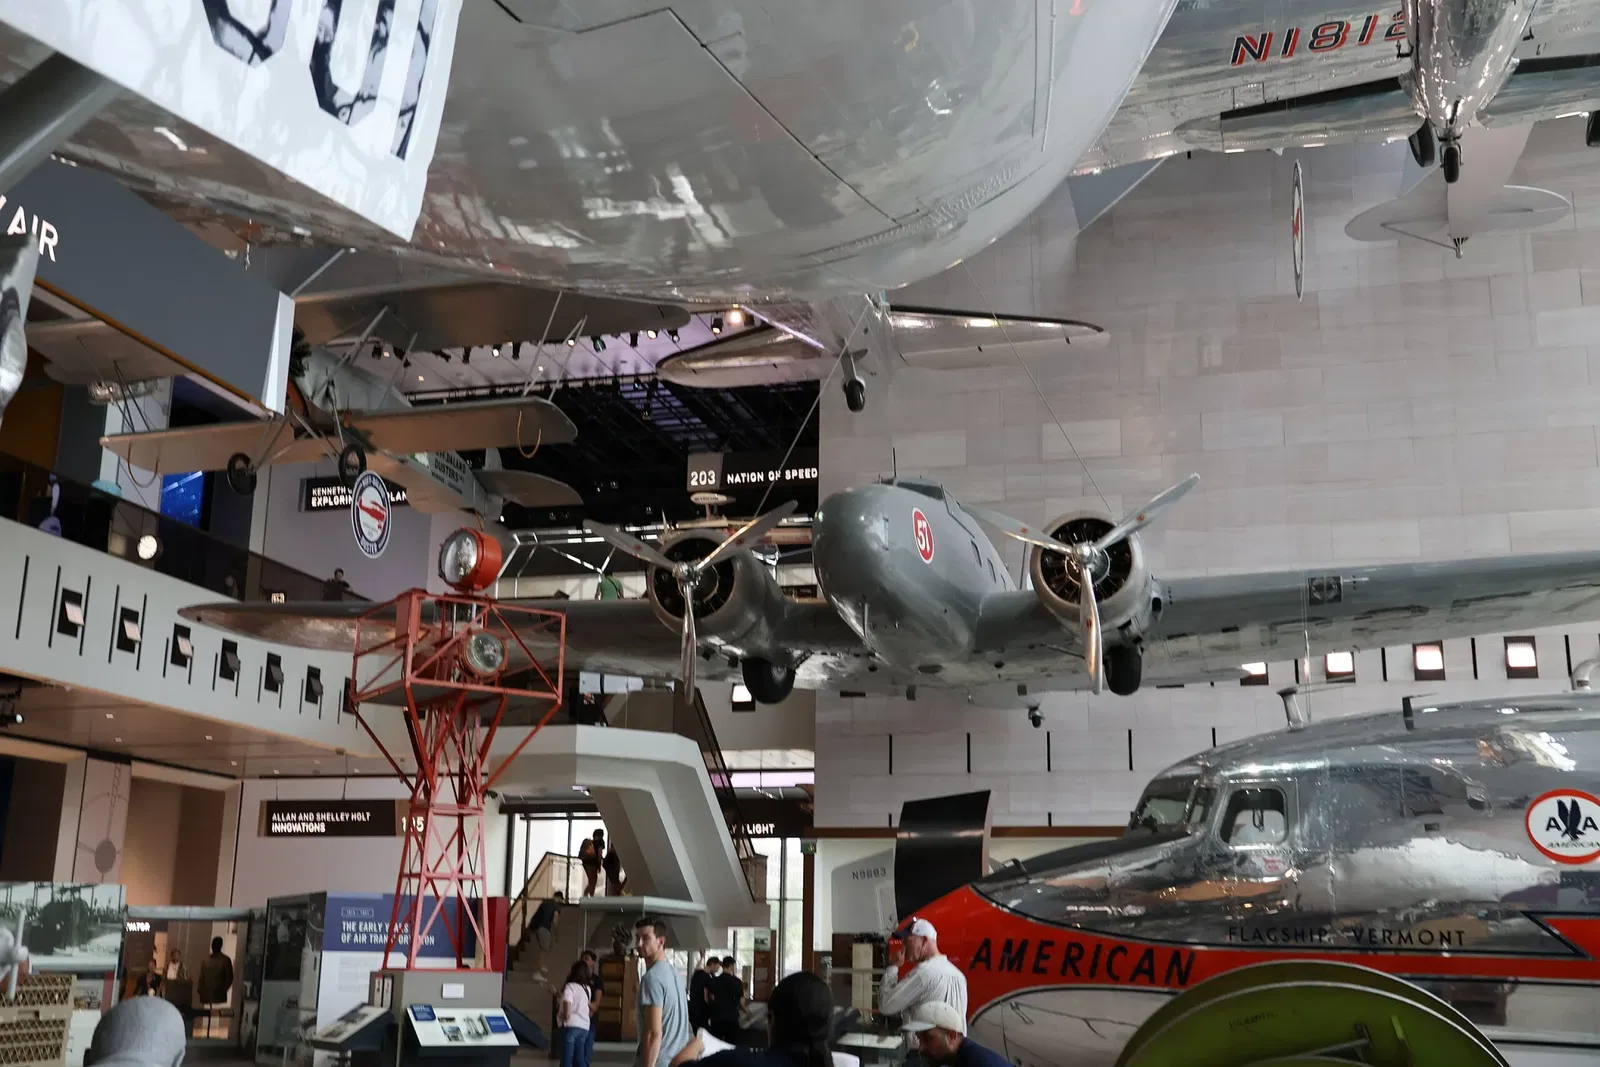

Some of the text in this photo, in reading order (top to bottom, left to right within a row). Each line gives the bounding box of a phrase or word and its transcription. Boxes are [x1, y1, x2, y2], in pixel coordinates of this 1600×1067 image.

[6, 205, 59, 263] AIR
[690, 470, 716, 486] 203
[727, 472, 764, 484] NATION
[785, 468, 818, 480] SPEED
[312, 486, 347, 497] KENNETH
[271, 812, 371, 822] ALLAN AND SHELLEY HOLT
[271, 822, 326, 833] INNOVATIONS
[342, 921, 357, 932] THE
[358, 921, 382, 932] EARLY
[341, 933, 352, 944] OF
[353, 933, 367, 944] AIR
[1228, 926, 1465, 947] FLAGSHIP VERMONT
[969, 937, 1196, 986] AMERICAN
